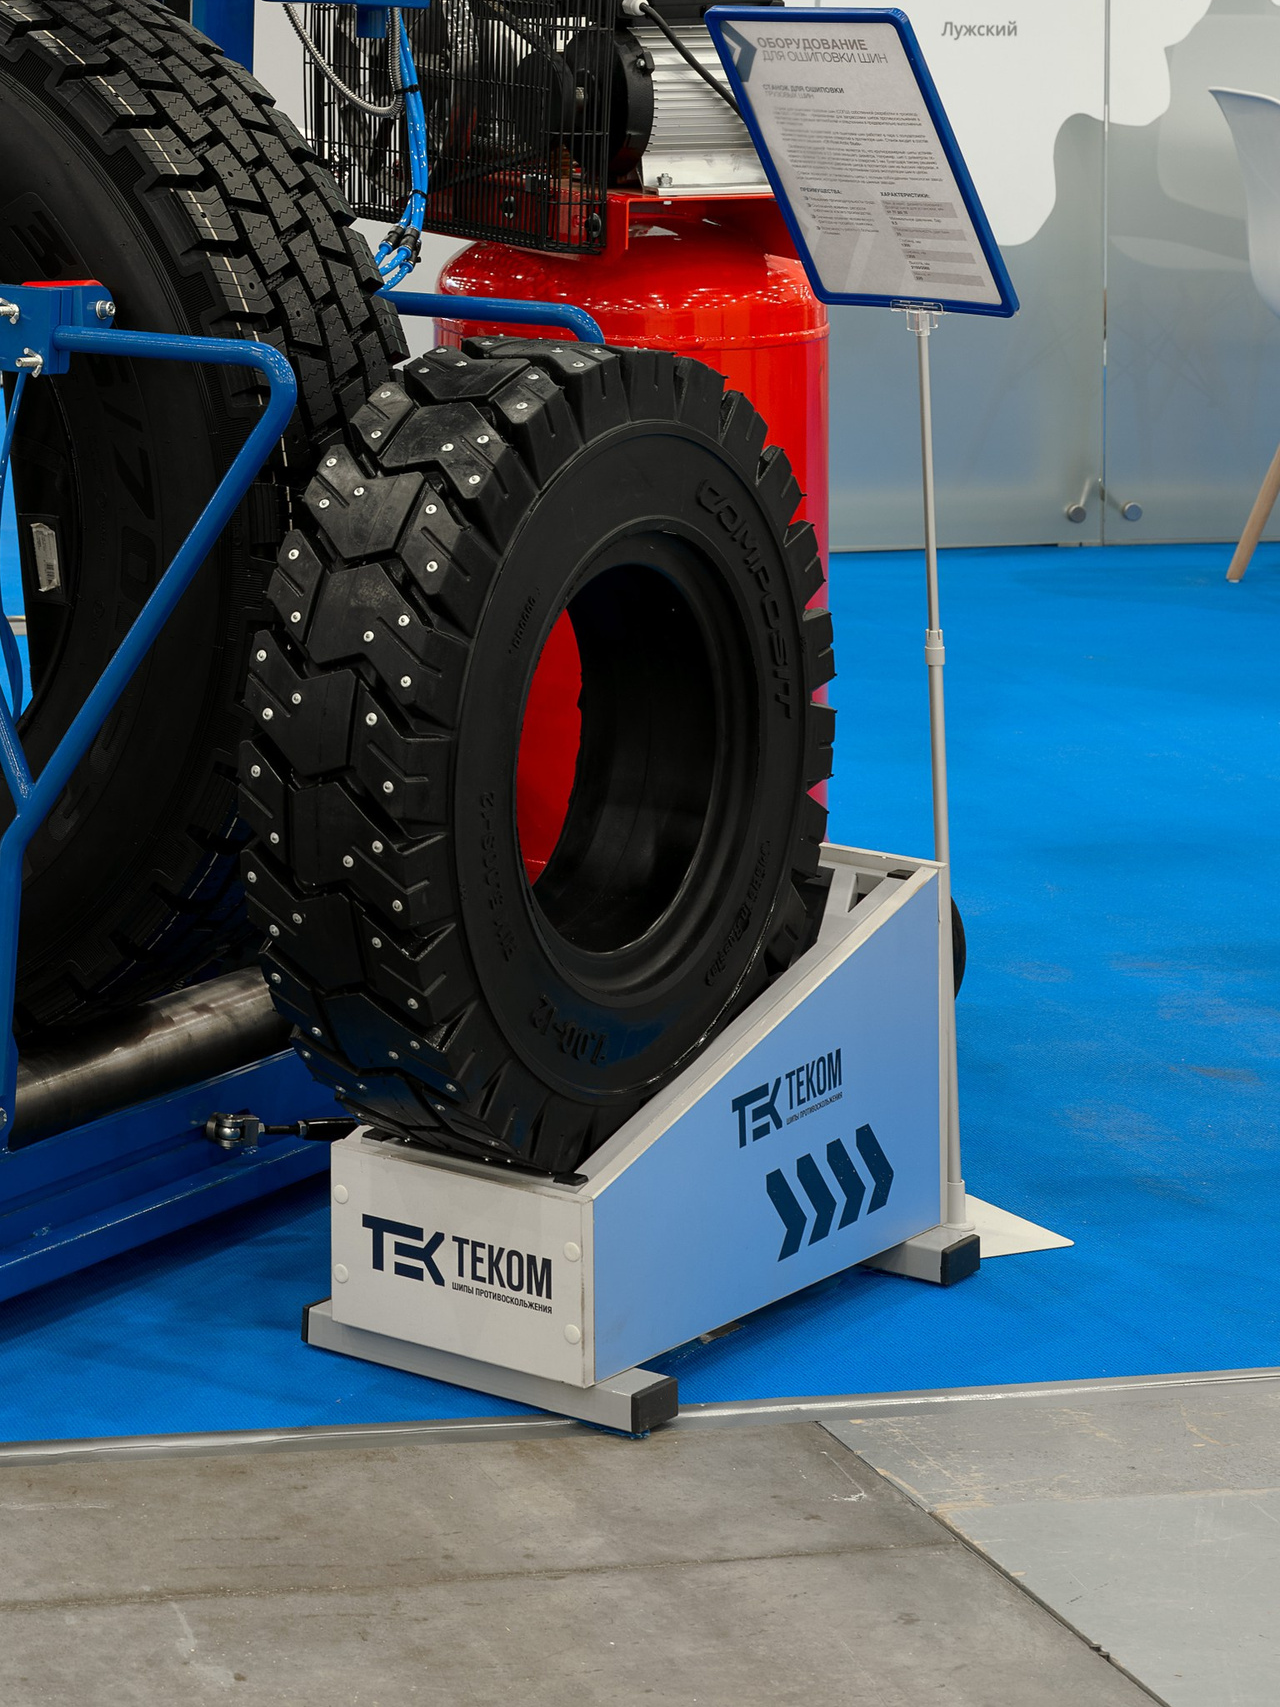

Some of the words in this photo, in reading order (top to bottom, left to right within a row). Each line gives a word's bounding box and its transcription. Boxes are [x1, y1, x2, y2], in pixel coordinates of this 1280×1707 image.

[757, 37, 868, 51] ОБОРУДОВАНИЕ
[941, 22, 1018, 41] Лужский
[762, 51, 786, 62] ДЛЯ
[787, 52, 856, 64] ОШИПОВКИ
[858, 53, 888, 64] ШИН
[805, 86, 845, 94] ОШИПОВКИ
[695, 478, 793, 720] COMPOSIT
[785, 1048, 842, 1110] ТЕКОМ
[799, 1092, 843, 1119] ПРОТИВОСКОЛЬЖЕНИЯ
[452, 1235, 552, 1300] ТЕКОМ
[452, 1281, 474, 1295] ШИПЫ
[475, 1288, 552, 1314] ПРОТИВОСКОЛЬЖЕНИЯ
